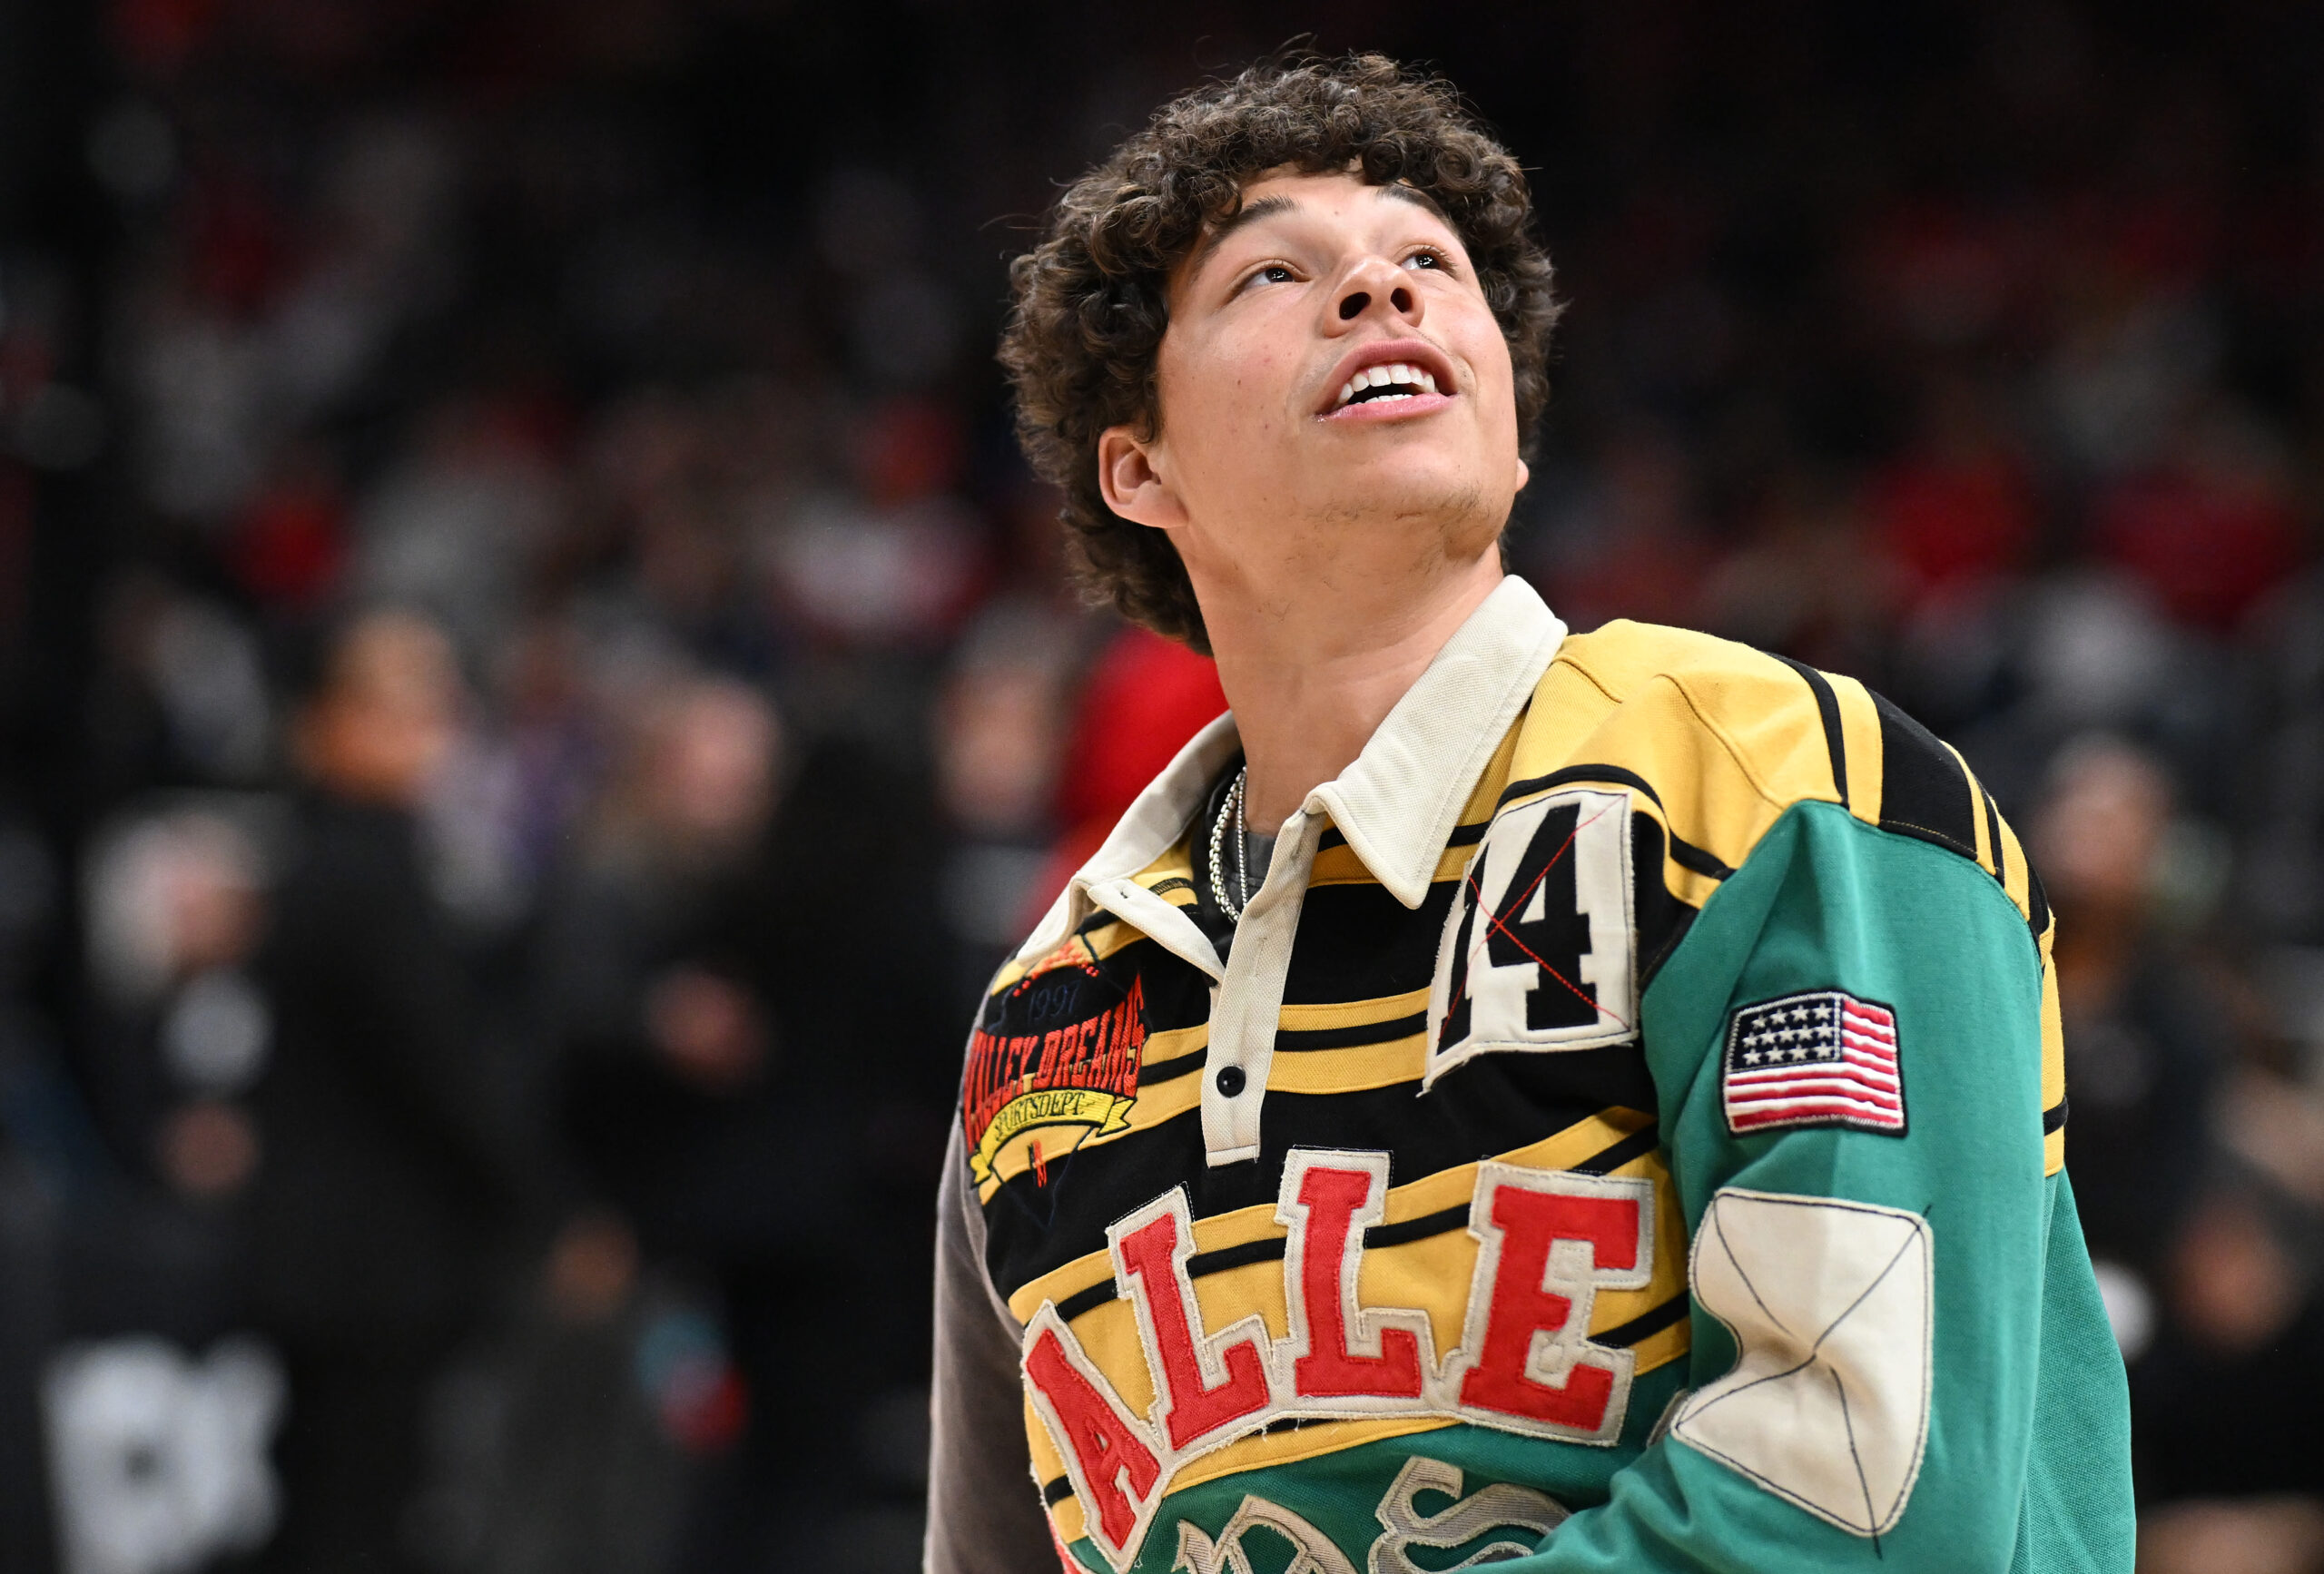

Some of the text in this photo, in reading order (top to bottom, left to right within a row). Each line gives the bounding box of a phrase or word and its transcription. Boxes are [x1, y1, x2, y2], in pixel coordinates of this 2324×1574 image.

[964, 973, 1145, 1155] ALLEY DREAMS
[1024, 1149, 1654, 1572] ALLE
